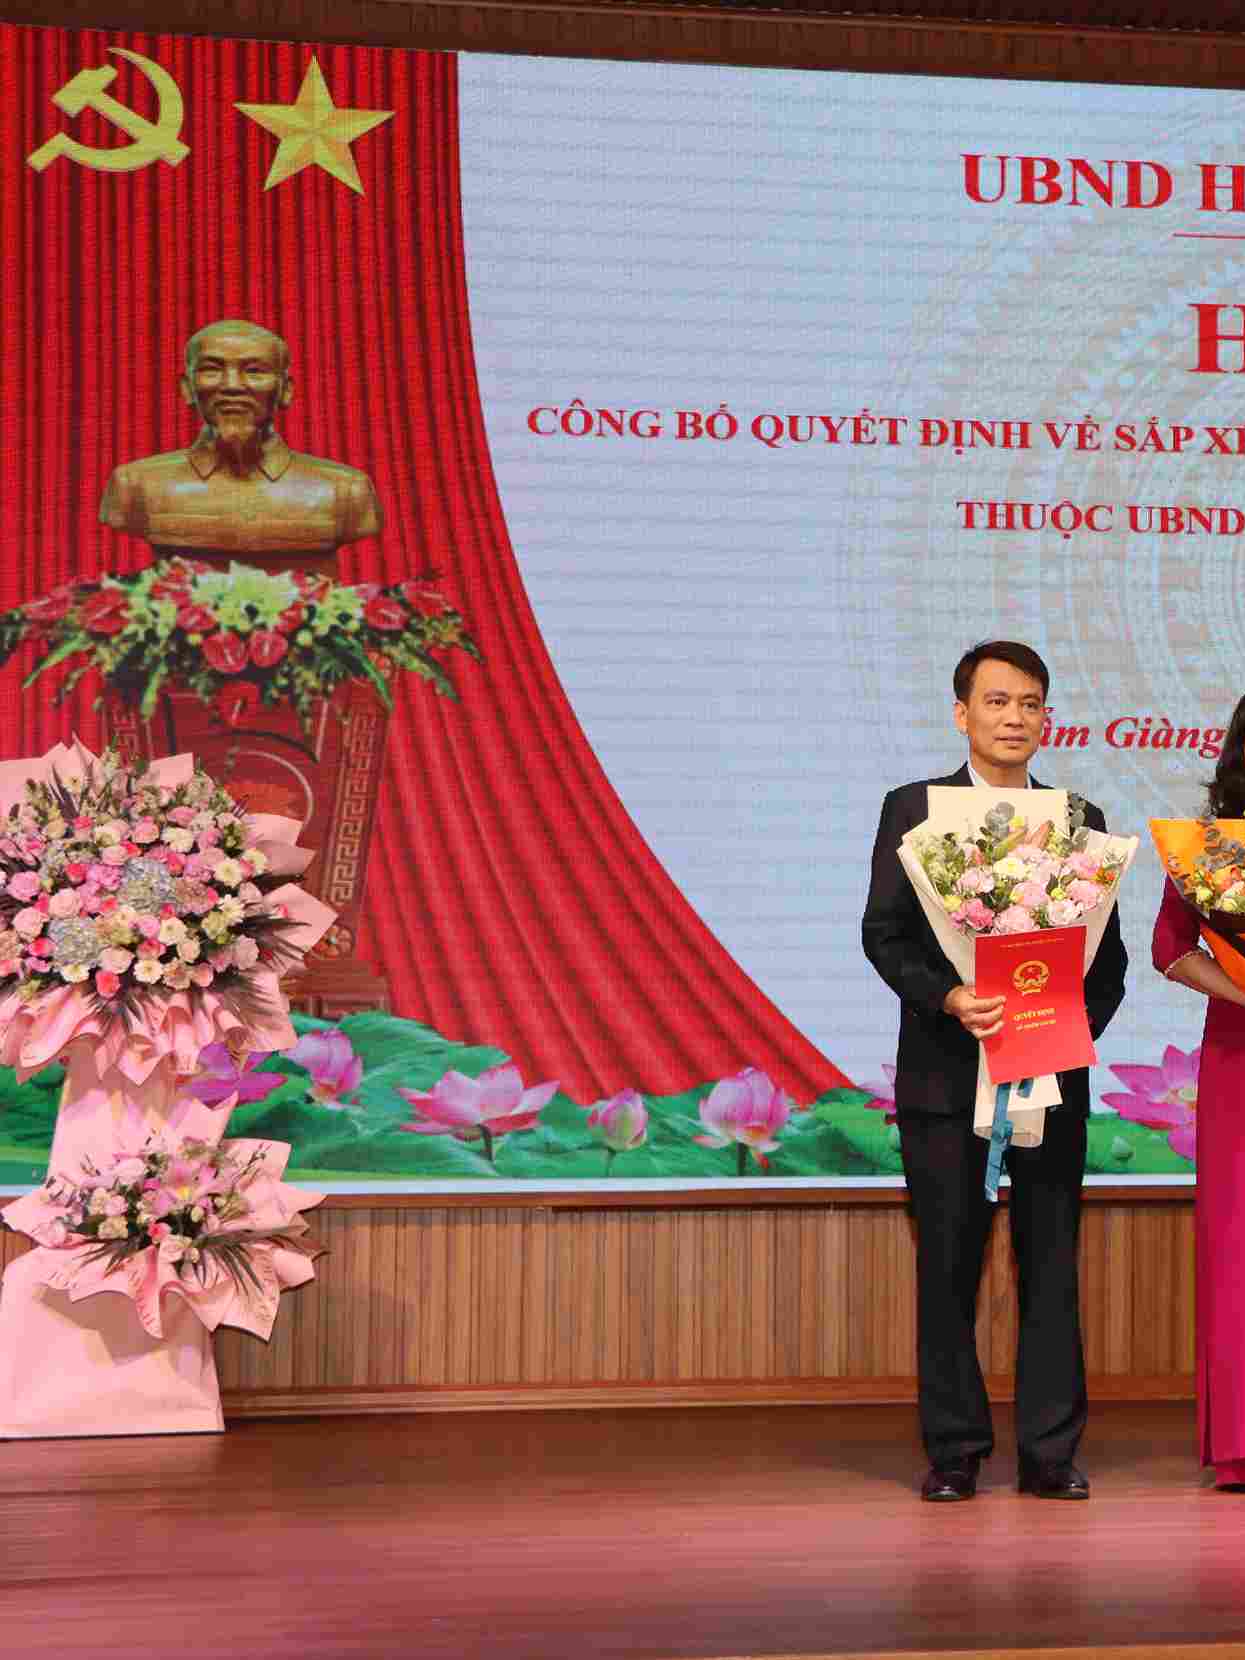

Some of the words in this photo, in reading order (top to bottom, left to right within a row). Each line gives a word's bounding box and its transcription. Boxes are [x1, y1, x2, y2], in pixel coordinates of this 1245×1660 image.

[961, 153, 1176, 209] UBND
[527, 398, 663, 439] CÔNG
[673, 401, 739, 441] BỐ
[750, 408, 908, 448] QUYẾT
[918, 418, 1031, 456] ĐỊNH
[1113, 416, 1196, 454] SẮP
[956, 499, 1114, 540] THUỘC
